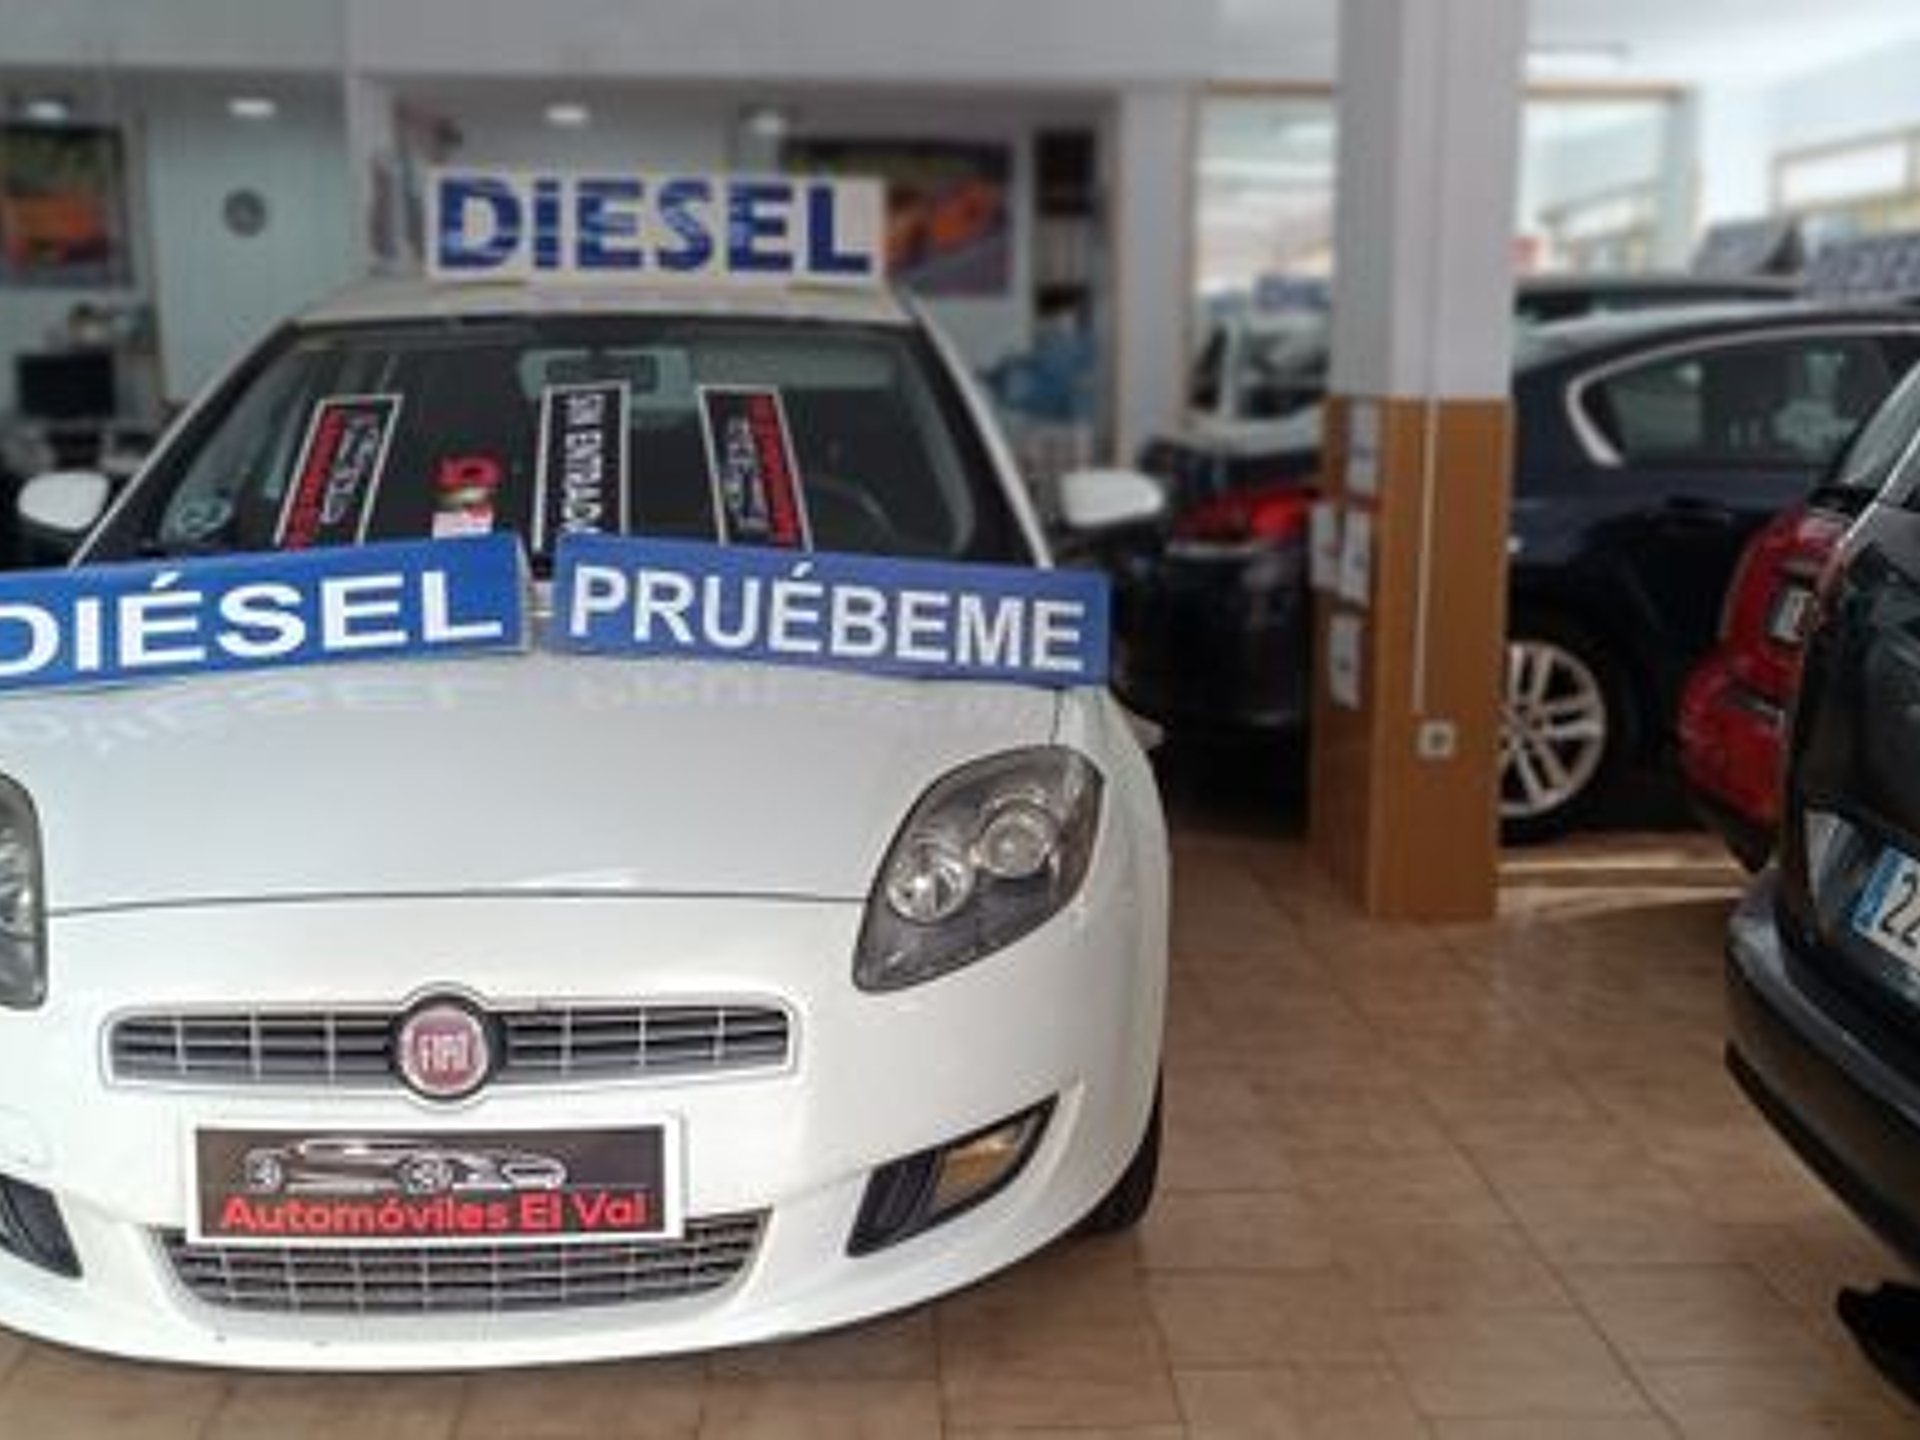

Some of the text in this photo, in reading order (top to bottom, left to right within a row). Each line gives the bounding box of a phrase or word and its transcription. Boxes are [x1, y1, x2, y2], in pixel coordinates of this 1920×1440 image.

[0, 570, 502, 676] DIÉSEL
[568, 562, 1086, 672] PRUÉBEME
[220, 1193, 508, 1232] Automóviles
[520, 1193, 562, 1230] El
